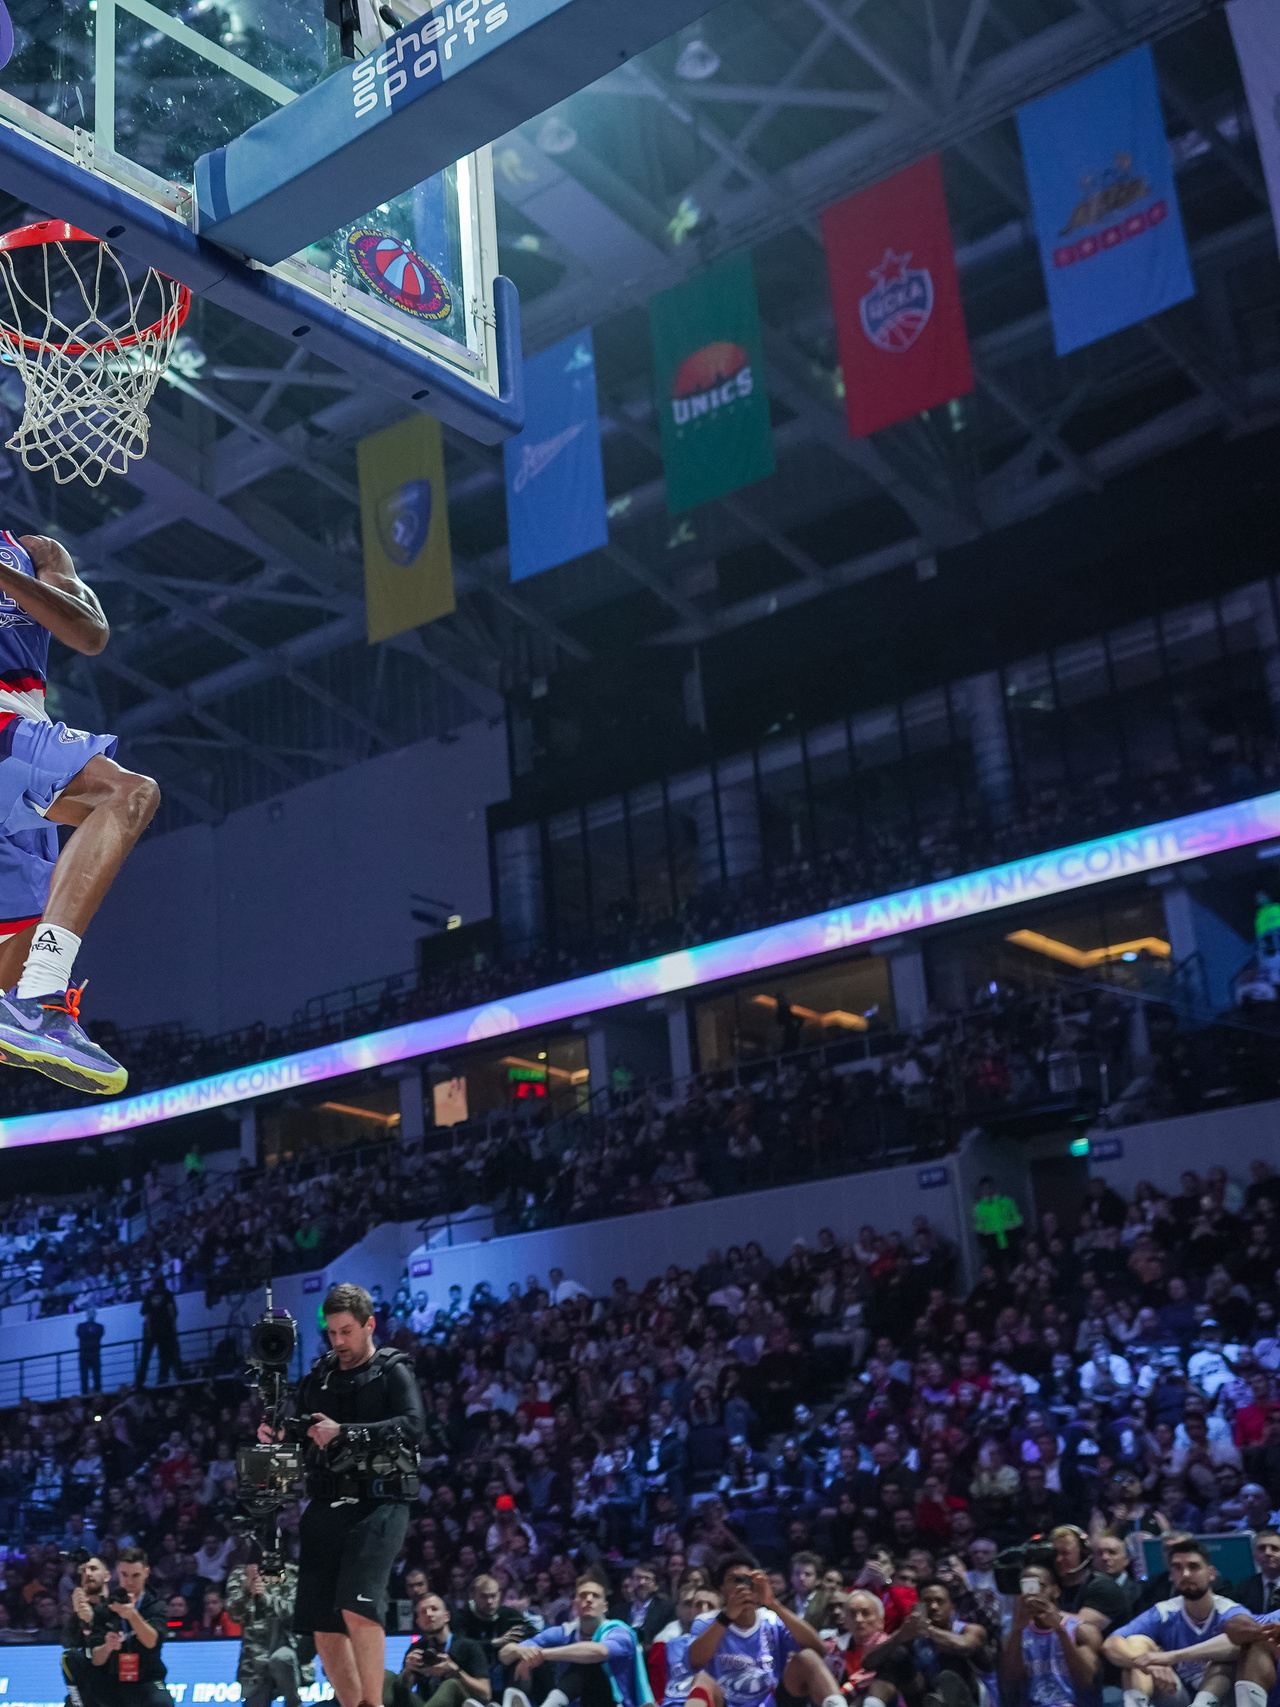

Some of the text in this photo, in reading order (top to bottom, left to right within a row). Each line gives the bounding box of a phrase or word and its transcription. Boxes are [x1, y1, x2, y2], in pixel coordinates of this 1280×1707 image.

[353, 2, 508, 119] Sports
[384, 294, 419, 316] LEAGUE
[416, 297, 441, 311] 2020
[672, 366, 753, 425] UNICS
[823, 892, 922, 948] SLAM
[931, 862, 1041, 919] DUNK
[98, 1097, 161, 1131] SLAM
[163, 1081, 226, 1116] DUNK
